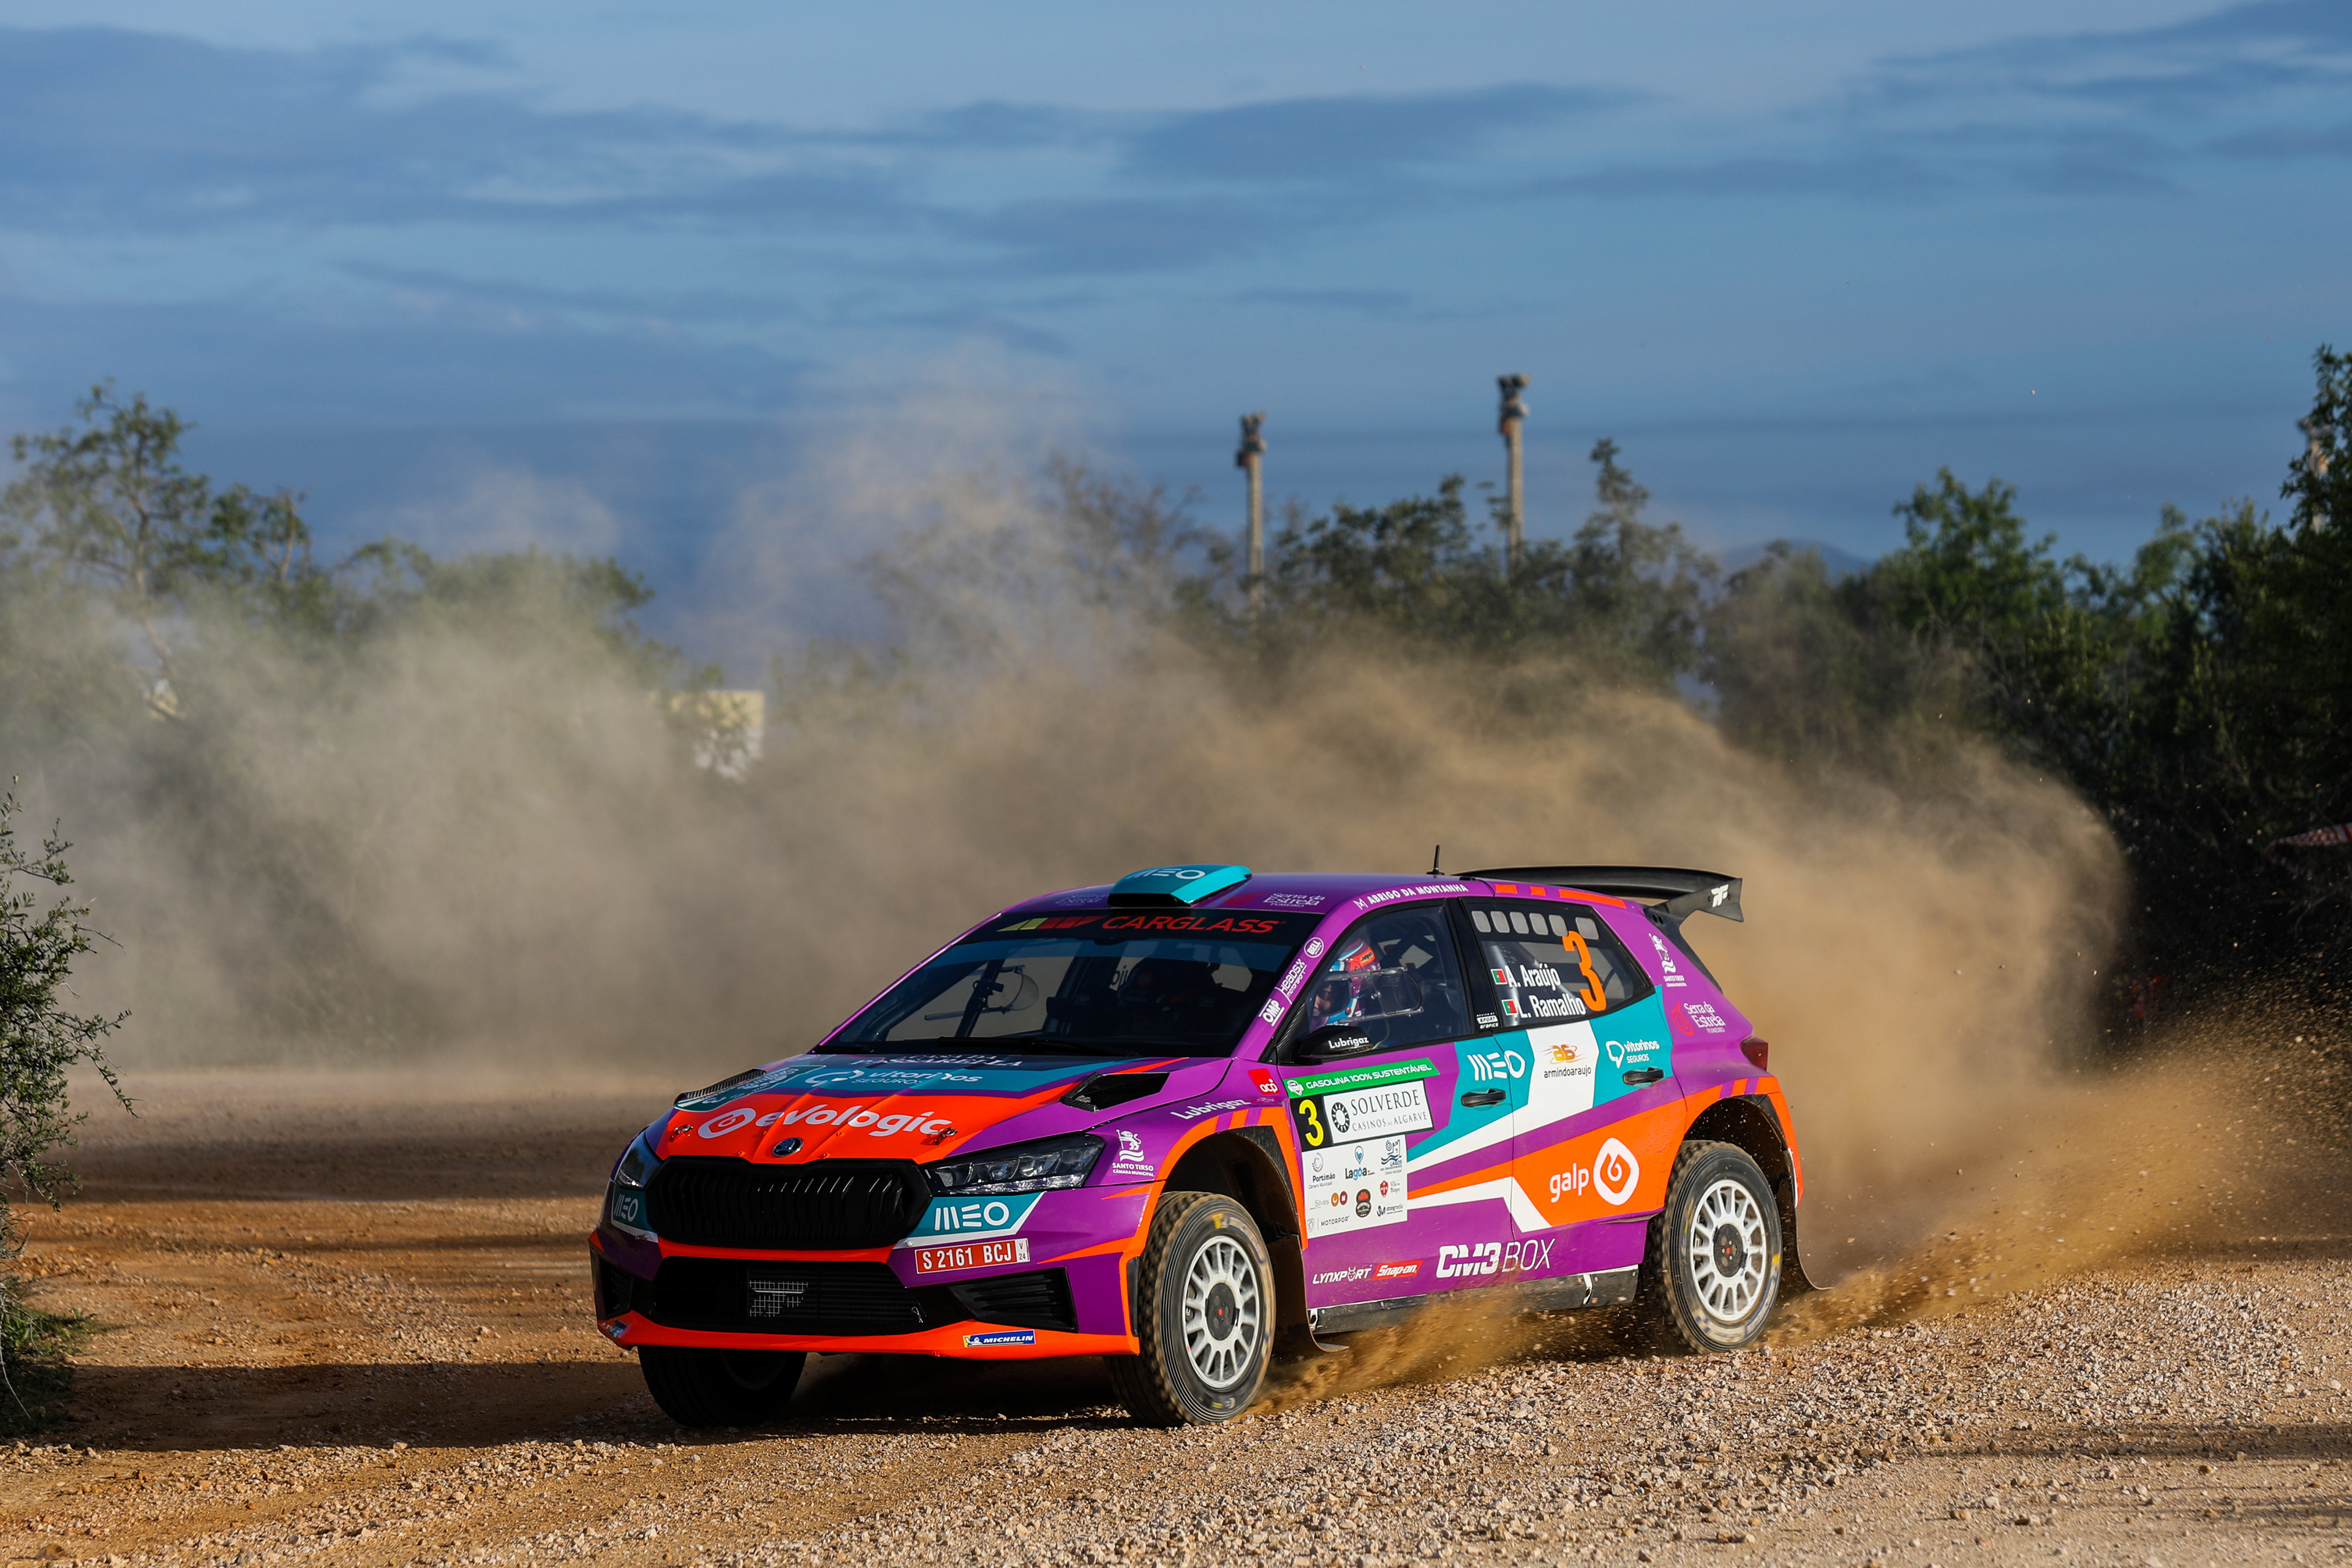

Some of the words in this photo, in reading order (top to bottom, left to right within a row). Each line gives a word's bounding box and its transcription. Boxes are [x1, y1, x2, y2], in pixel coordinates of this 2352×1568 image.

[1127, 869, 1205, 880] MEO
[1367, 891, 1401, 905] ABRIGO
[1401, 888, 1417, 897] DA
[1415, 884, 1469, 895] MONTANHA
[1102, 916, 1280, 933] CARGLASS
[1306, 940, 1321, 955] BELL
[1504, 965, 1521, 988] A.
[1520, 963, 1561, 991] Araújo
[1562, 930, 1607, 1012] 3
[1262, 1000, 1281, 1023] OMP
[1514, 995, 1532, 1018] L.
[1529, 993, 1586, 1017] Ramalho
[1684, 1003, 1705, 1014] Serra
[1703, 1001, 1716, 1012] da
[1691, 1013, 1726, 1028] Estrela
[1328, 1036, 1370, 1049] Lubrigaz
[1624, 1039, 1660, 1052] vitorinos
[1467, 1050, 1526, 1081] MEO
[1626, 1054, 1649, 1063] SEGUROS
[1306, 1077, 1349, 1090] GASOLINA
[1349, 1073, 1373, 1082] 100%
[1374, 1064, 1432, 1079] SUSTENTÁVEL
[1544, 1065, 1592, 1078] armindoaraujo
[1259, 1082, 1278, 1093] acp
[1170, 1099, 1251, 1120] Lubrigaz
[1351, 1089, 1420, 1115] SOLVERDE
[755, 1104, 953, 1137] evologic
[1298, 1099, 1324, 1147] 3
[1352, 1120, 1387, 1131] CASINOS
[1393, 1112, 1428, 1125] ALGARVE
[1313, 1172, 1336, 1183] Portimão
[1345, 1167, 1367, 1180] Lagoa
[1549, 1163, 1589, 1203] galp
[614, 1194, 638, 1221] MEO
[935, 1202, 1009, 1231] MEO
[922, 1251, 933, 1270] S
[937, 1247, 973, 1268] 2161
[982, 1243, 1012, 1264] BCJ
[1376, 1263, 1416, 1277] Snap-on
